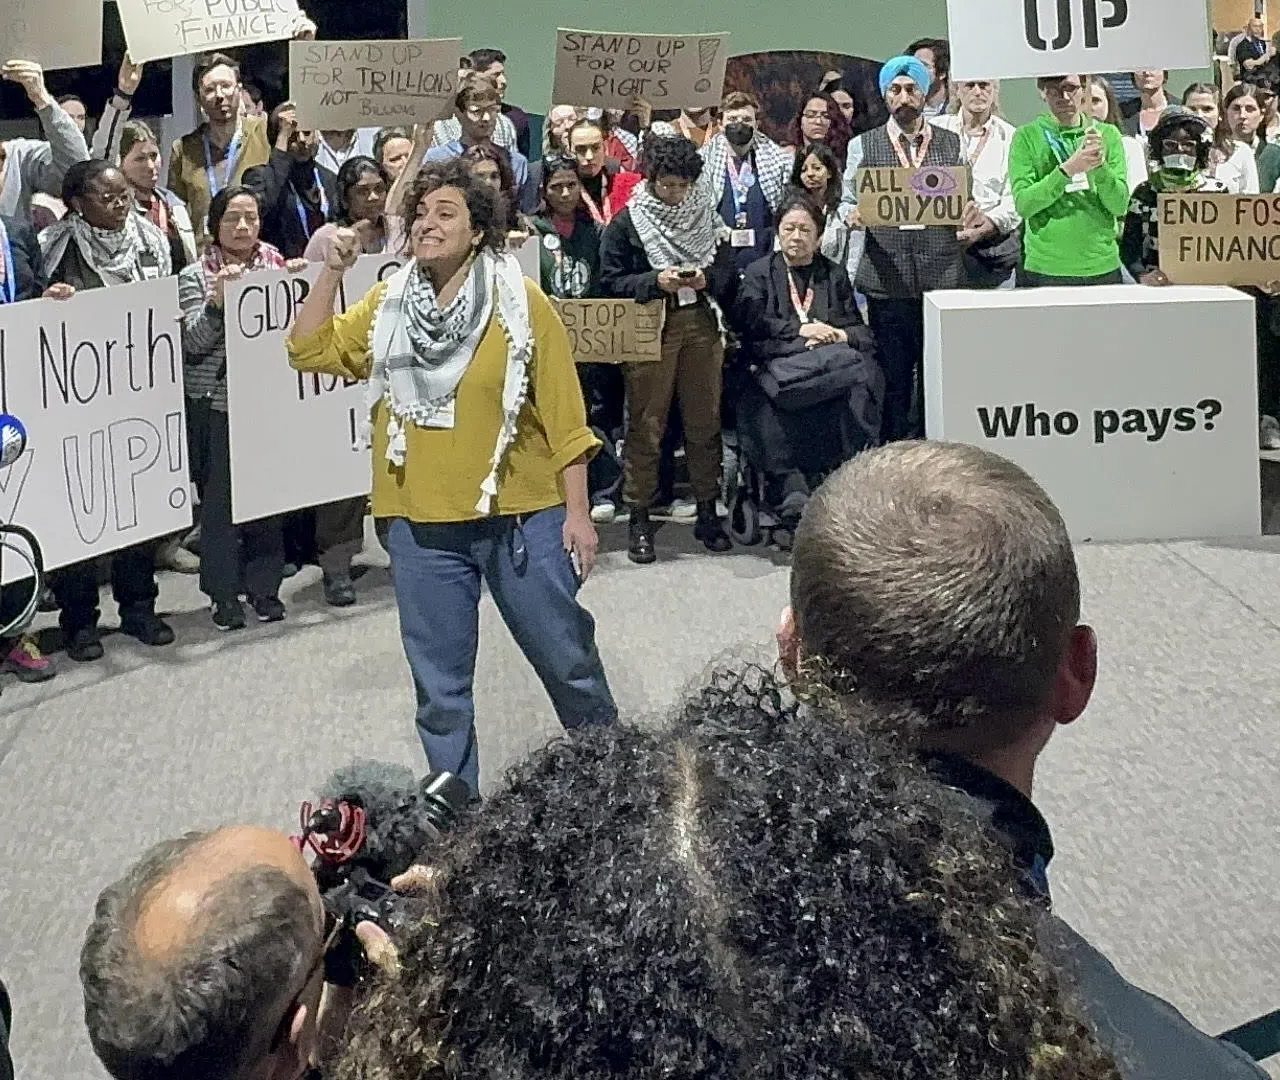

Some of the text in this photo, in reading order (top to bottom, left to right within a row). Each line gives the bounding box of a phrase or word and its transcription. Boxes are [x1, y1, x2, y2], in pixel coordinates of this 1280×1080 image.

[180, 16, 277, 45] FINANCE
[305, 44, 423, 66] STAND UP
[563, 33, 686, 58] STAND UP
[573, 54, 672, 74] FOR OUR
[299, 65, 453, 94] FOR TRILLIONS
[591, 74, 669, 97] RIGHTS
[320, 89, 358, 106] NOT
[860, 169, 902, 193] ALL
[877, 195, 963, 222] ON YOU
[1163, 198, 1219, 225] END
[238, 277, 347, 339] GLOB
[562, 301, 626, 327] STOP
[569, 328, 633, 356] OSSIL
[39, 307, 176, 409] North
[977, 398, 1223, 444] Who pays?
[62, 411, 187, 545] UP!
